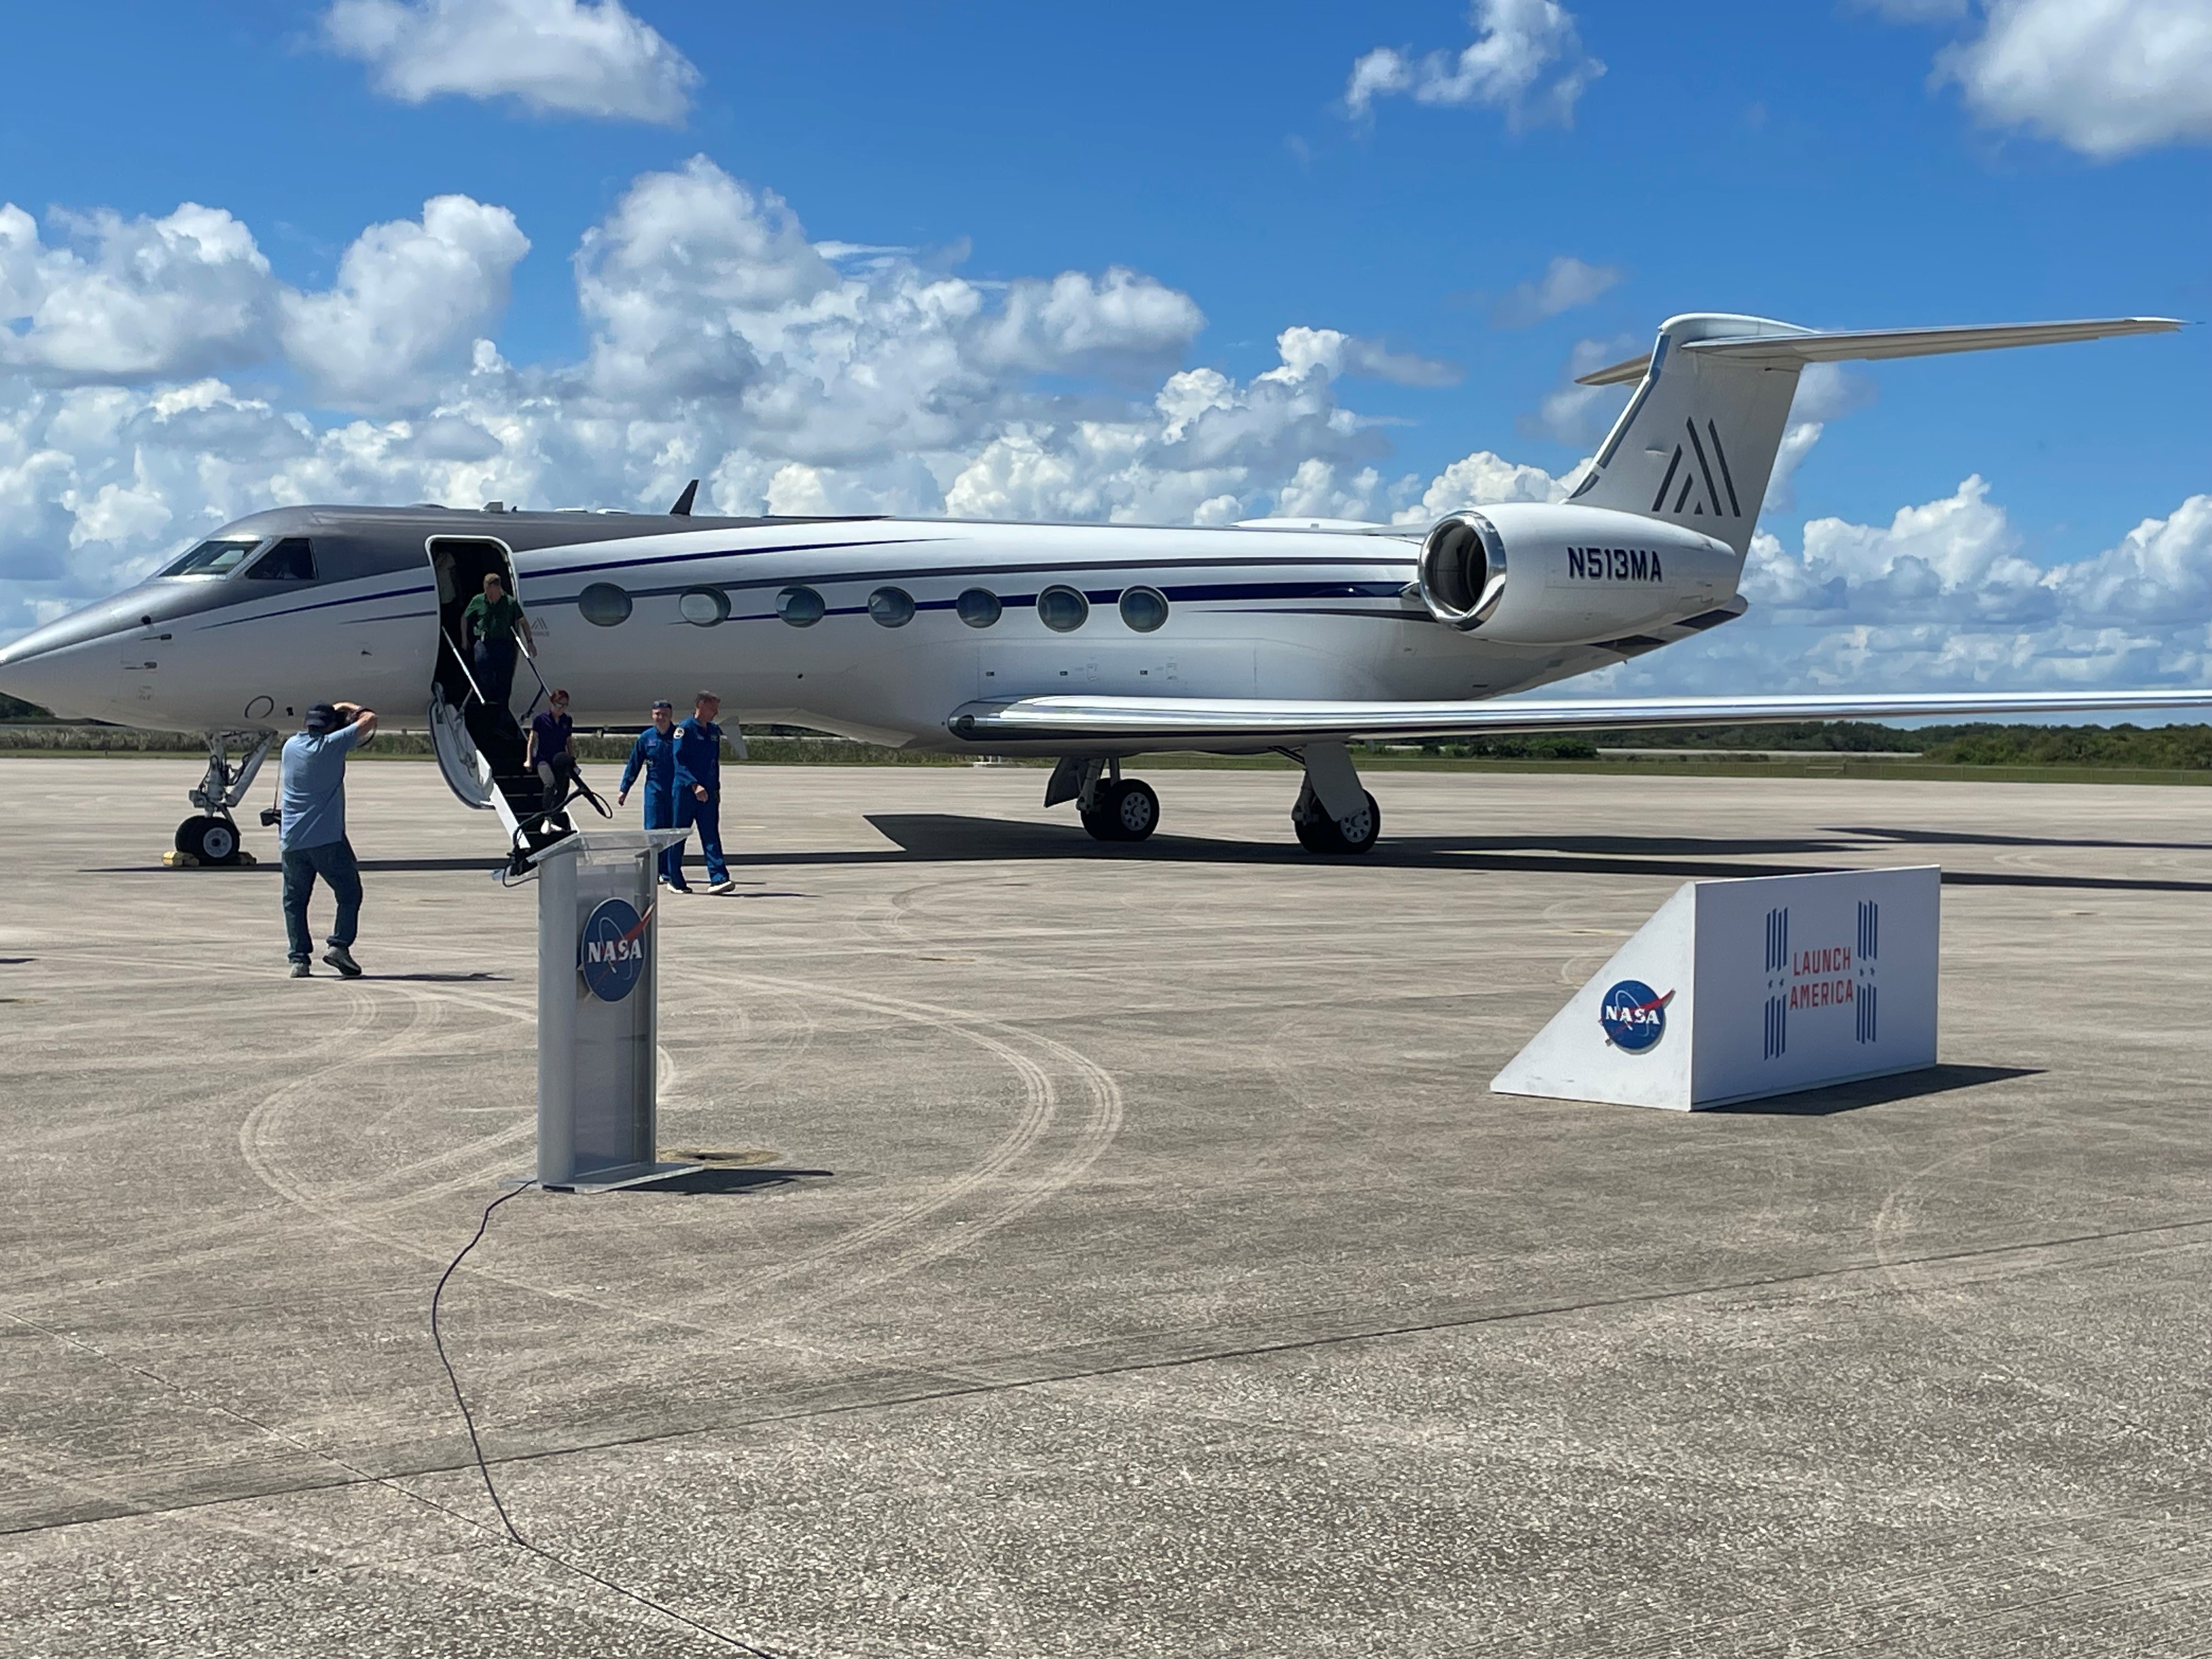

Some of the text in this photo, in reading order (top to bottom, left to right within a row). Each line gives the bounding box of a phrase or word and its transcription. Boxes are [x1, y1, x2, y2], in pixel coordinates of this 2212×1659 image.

[1567, 546, 1663, 583] N513MA
[588, 938, 642, 963] NASA
[1793, 946, 1851, 976] LAUNCH
[1789, 979, 1854, 1011] AMERICA
[1605, 1005, 1661, 1025] NASA
